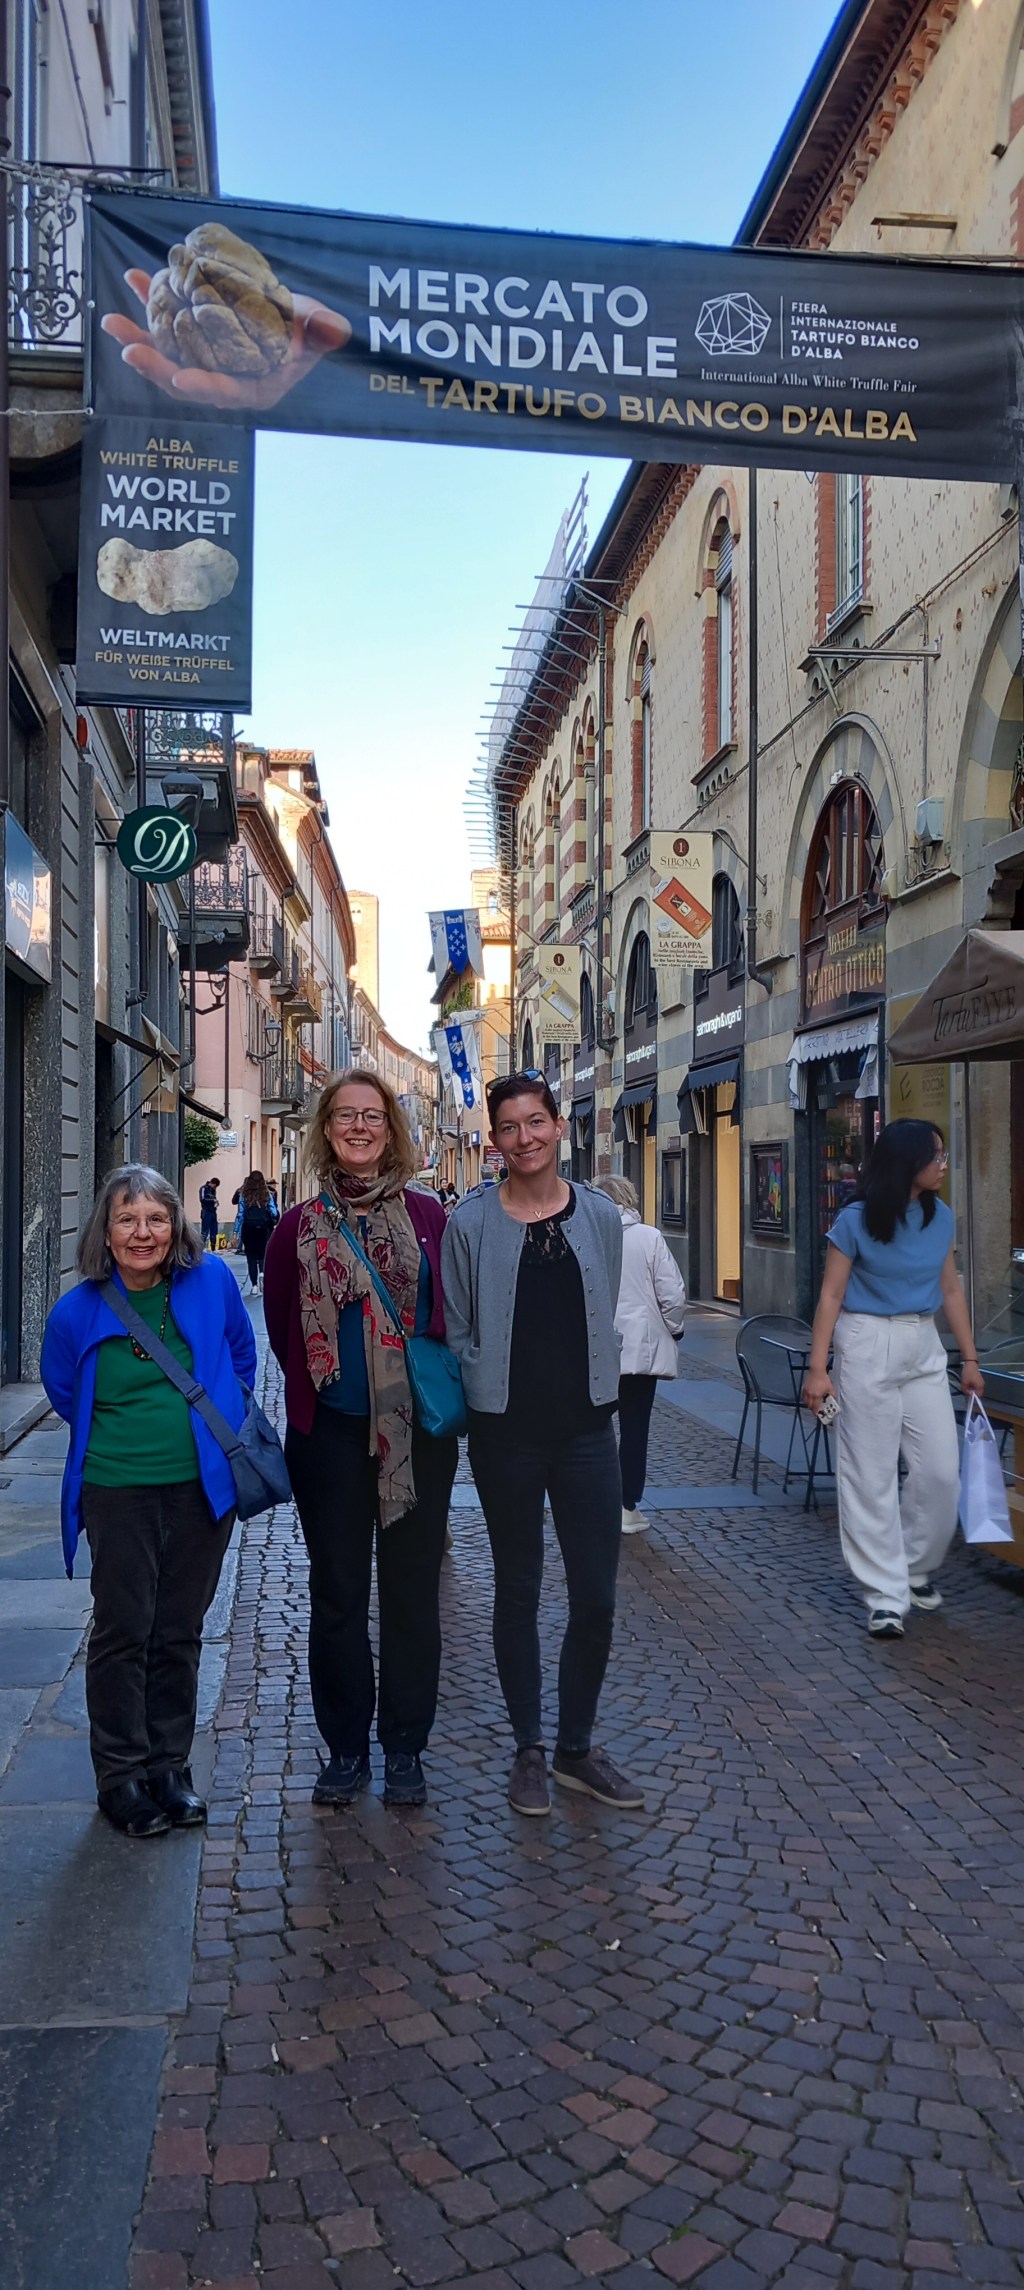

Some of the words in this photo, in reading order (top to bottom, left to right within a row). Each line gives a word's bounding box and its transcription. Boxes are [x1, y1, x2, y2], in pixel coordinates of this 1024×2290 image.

[369, 265, 648, 326] MERCATO
[791, 302, 827, 314] FIERA
[791, 315, 897, 333] INTERNAZIONALE
[369, 316, 677, 378] MONDIALE
[791, 330, 855, 345] TARTUFO
[861, 335, 919, 350] BIANCO
[791, 345, 843, 360] D'ALBA
[701, 368, 777, 384] International
[781, 374, 808, 387] Alba
[812, 375, 846, 389] White
[850, 377, 889, 391] Truffle
[893, 380, 917, 393] Fair
[369, 373, 415, 394] DEL
[419, 377, 607, 420] TARTUFO
[619, 395, 769, 431] BIANCO
[782, 405, 917, 442] D’ALBA
[146, 437, 193, 453] ALBA
[100, 450, 158, 467] WHITE
[162, 455, 239, 473] TRUFFLE
[107, 474, 231, 505] WORLD
[101, 503, 236, 535] MARKET
[100, 628, 231, 651] WELTMARKT
[95, 650, 122, 663] FÜR
[174, 655, 235, 671] TRÜFFEL
[129, 668, 159, 681] VON
[162, 671, 200, 683] ALBA
[660, 856, 701, 867] SIBONA
[670, 941, 702, 949] GRAPPA
[806, 964, 841, 1008] CENTRO
[845, 944, 884, 993] OTTICO
